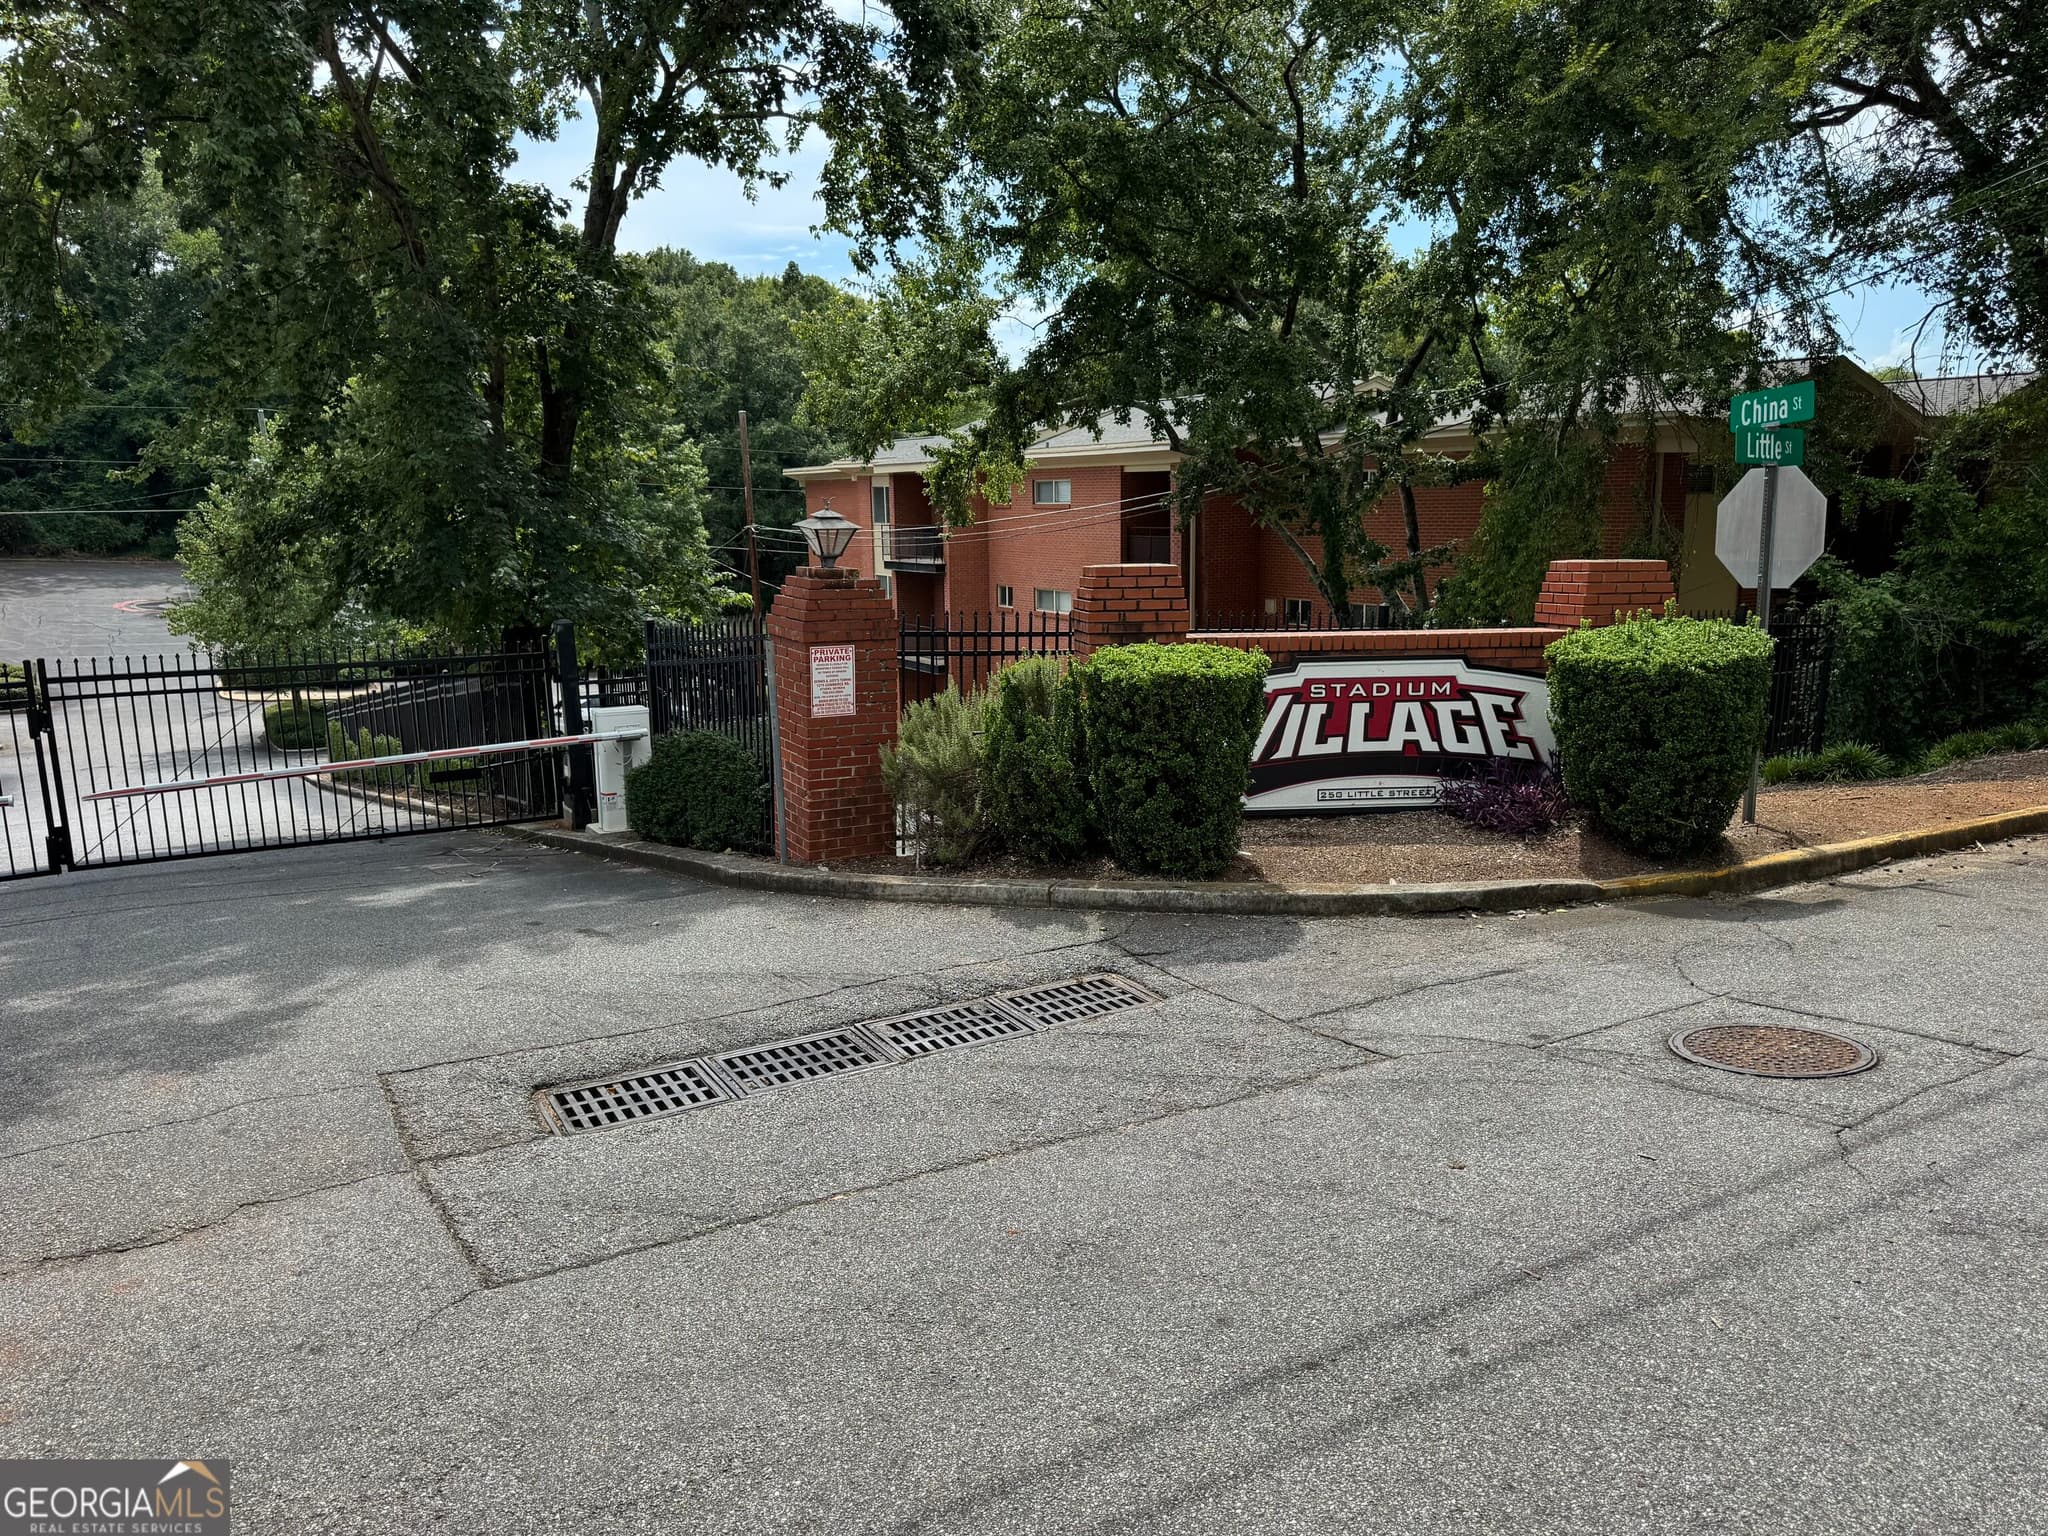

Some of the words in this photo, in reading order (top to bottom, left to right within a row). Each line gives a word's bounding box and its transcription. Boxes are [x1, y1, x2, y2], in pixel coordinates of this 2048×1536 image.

[1741, 395, 1788, 426] China
[1792, 396, 1802, 410] St
[1747, 432, 1782, 460] Little
[1785, 441, 1792, 454] St
[813, 654, 851, 663] PARKING
[1310, 681, 1451, 698] STADIUM
[1319, 791, 1342, 799] 250
[1347, 790, 1384, 798] LITTLE
[1388, 788, 1433, 797] STREET
